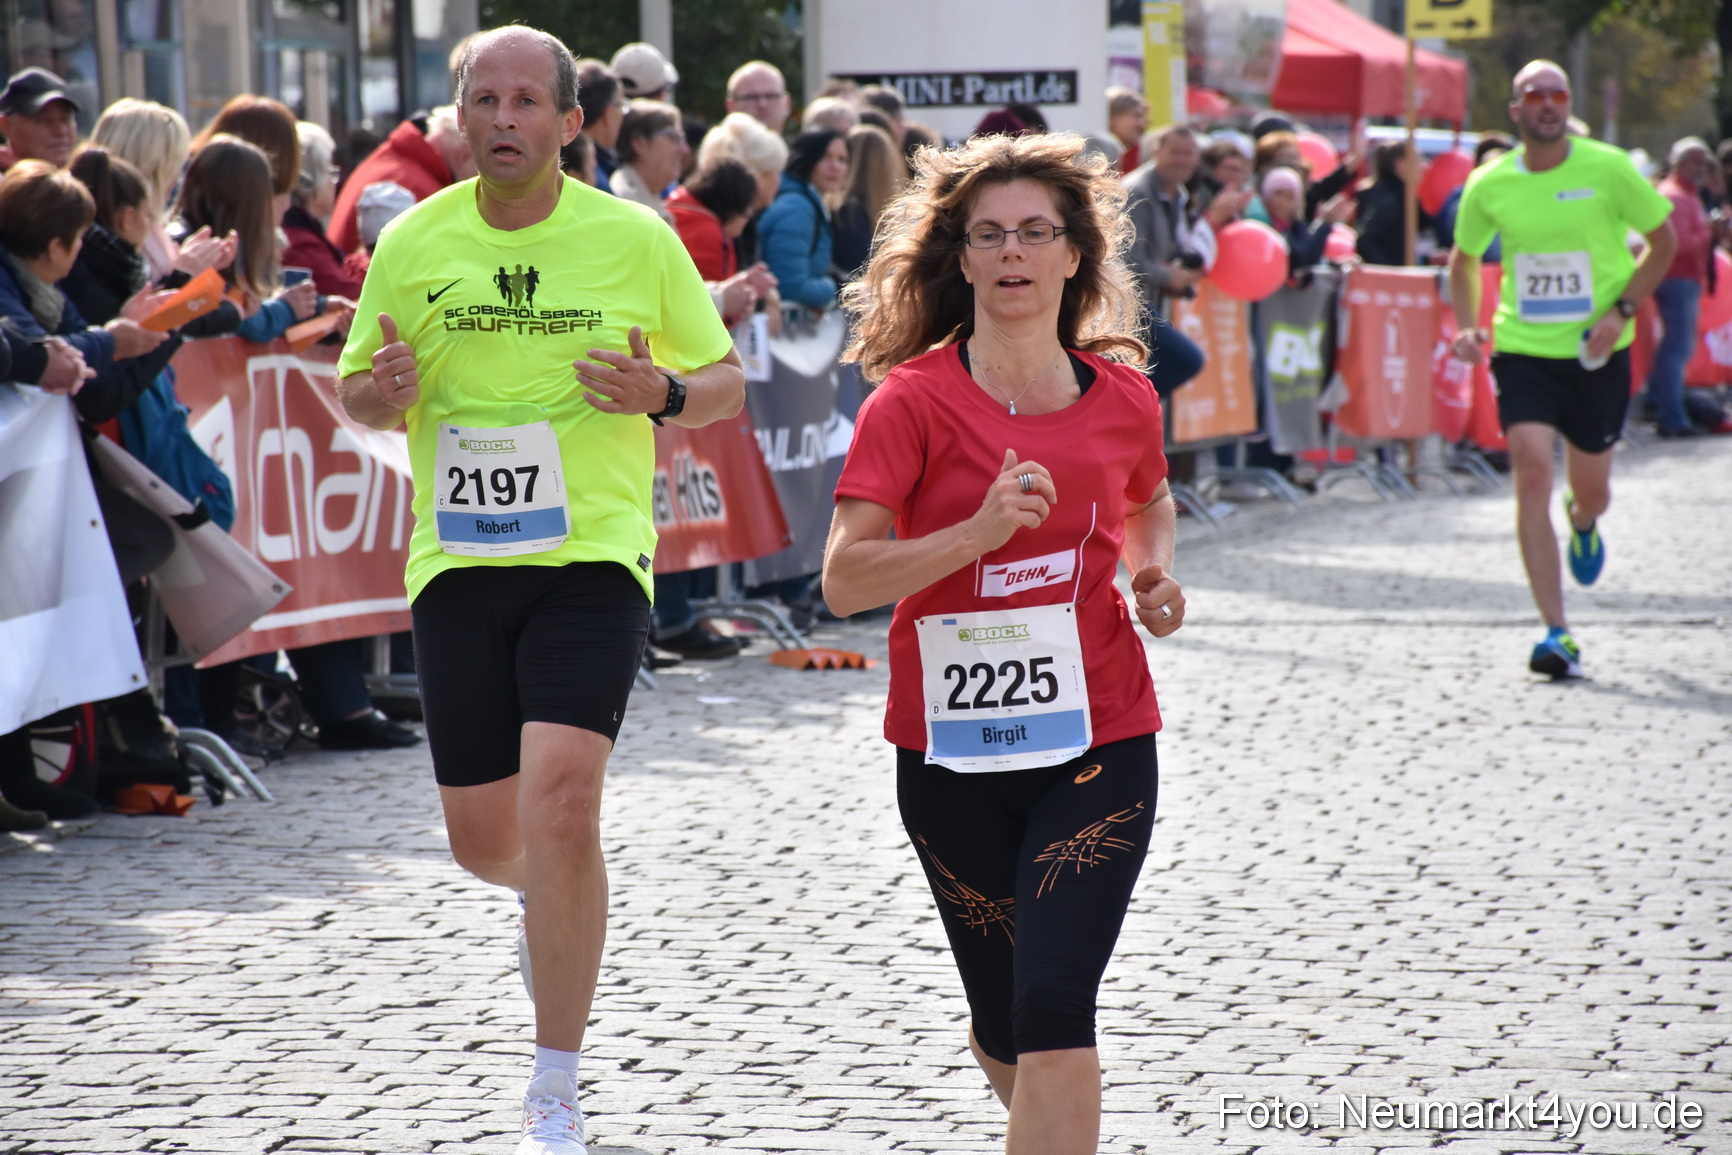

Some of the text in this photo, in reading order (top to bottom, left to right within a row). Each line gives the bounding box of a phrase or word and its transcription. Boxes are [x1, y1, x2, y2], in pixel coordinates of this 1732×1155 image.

[1527, 272, 1581, 296] 2713
[444, 307, 464, 319] SC
[469, 439, 517, 451] BOCK
[448, 465, 540, 507] 2197
[476, 519, 521, 534] Robert
[1005, 565, 1049, 586] DEHN
[973, 624, 1030, 641] BOCK
[944, 656, 1058, 710] 2225
[982, 724, 1028, 746] Birgit
